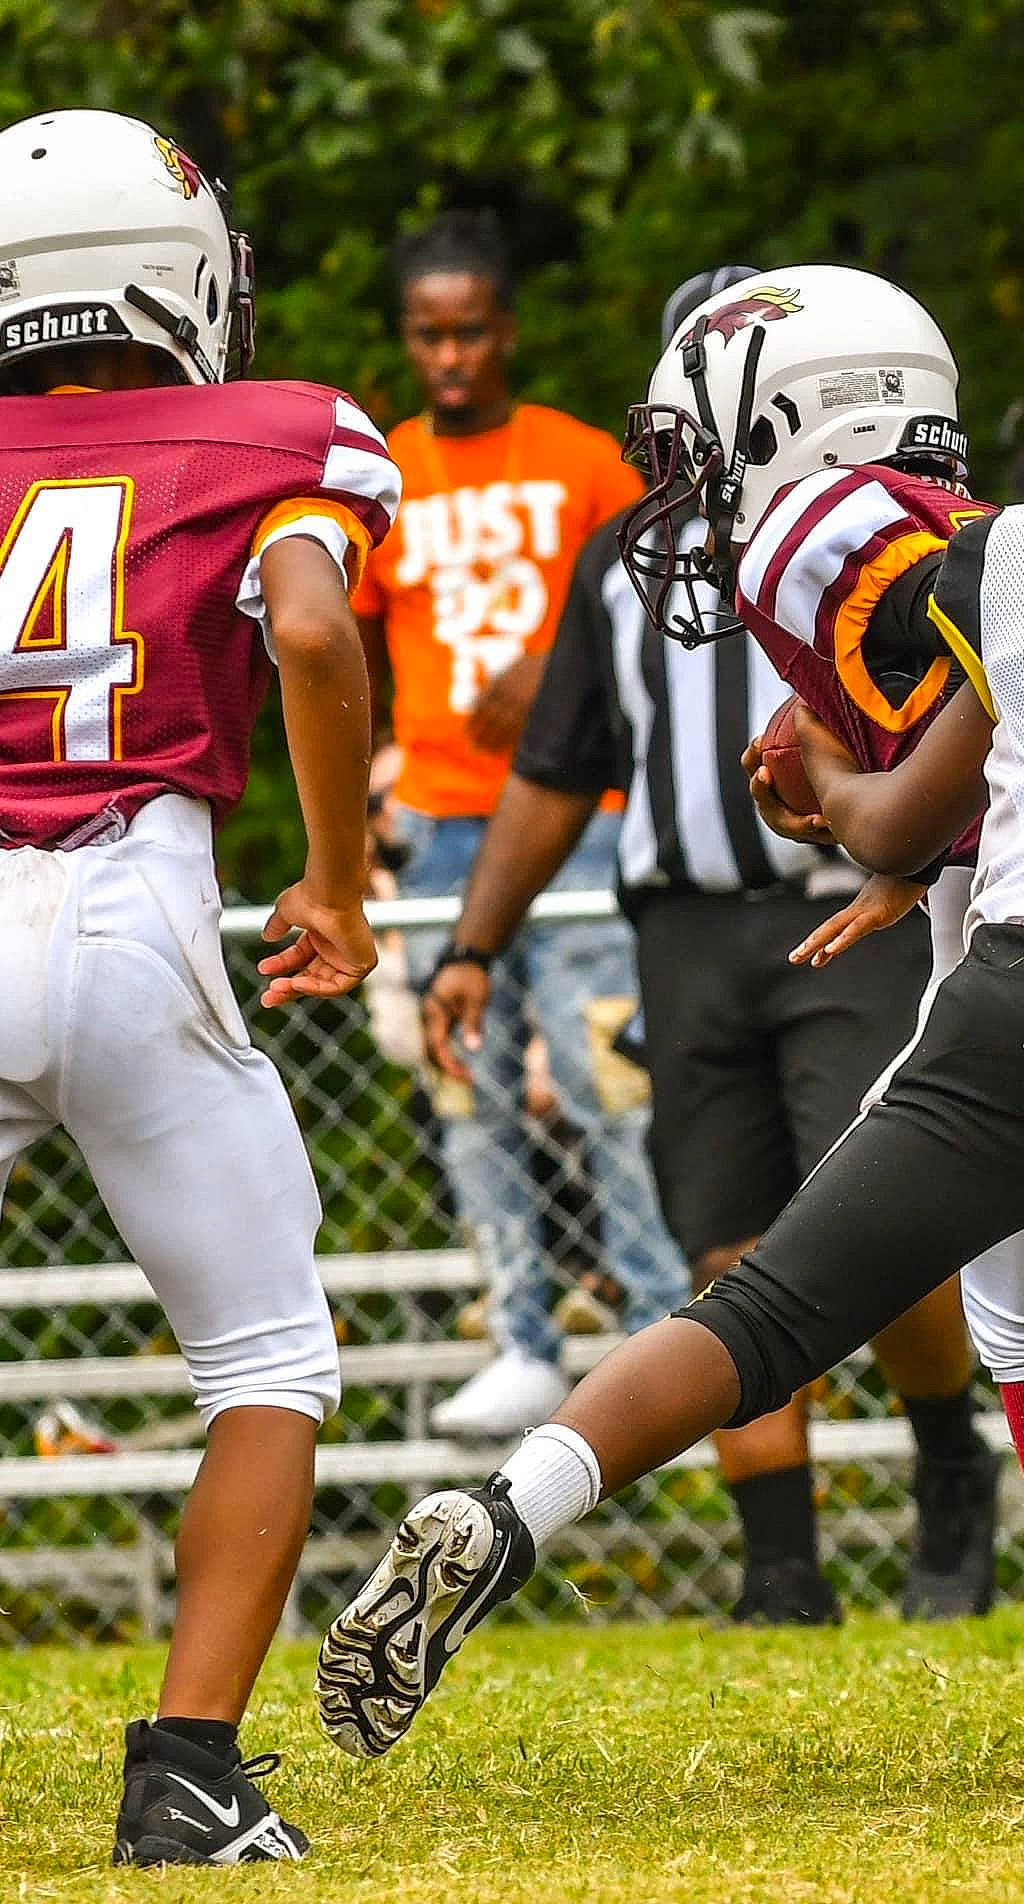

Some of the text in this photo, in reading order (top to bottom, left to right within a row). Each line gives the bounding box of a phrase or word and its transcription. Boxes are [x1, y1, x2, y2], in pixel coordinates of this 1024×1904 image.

[6, 307, 109, 349] schutt
[395, 480, 567, 586] JUST
[0, 475, 145, 763] 4
